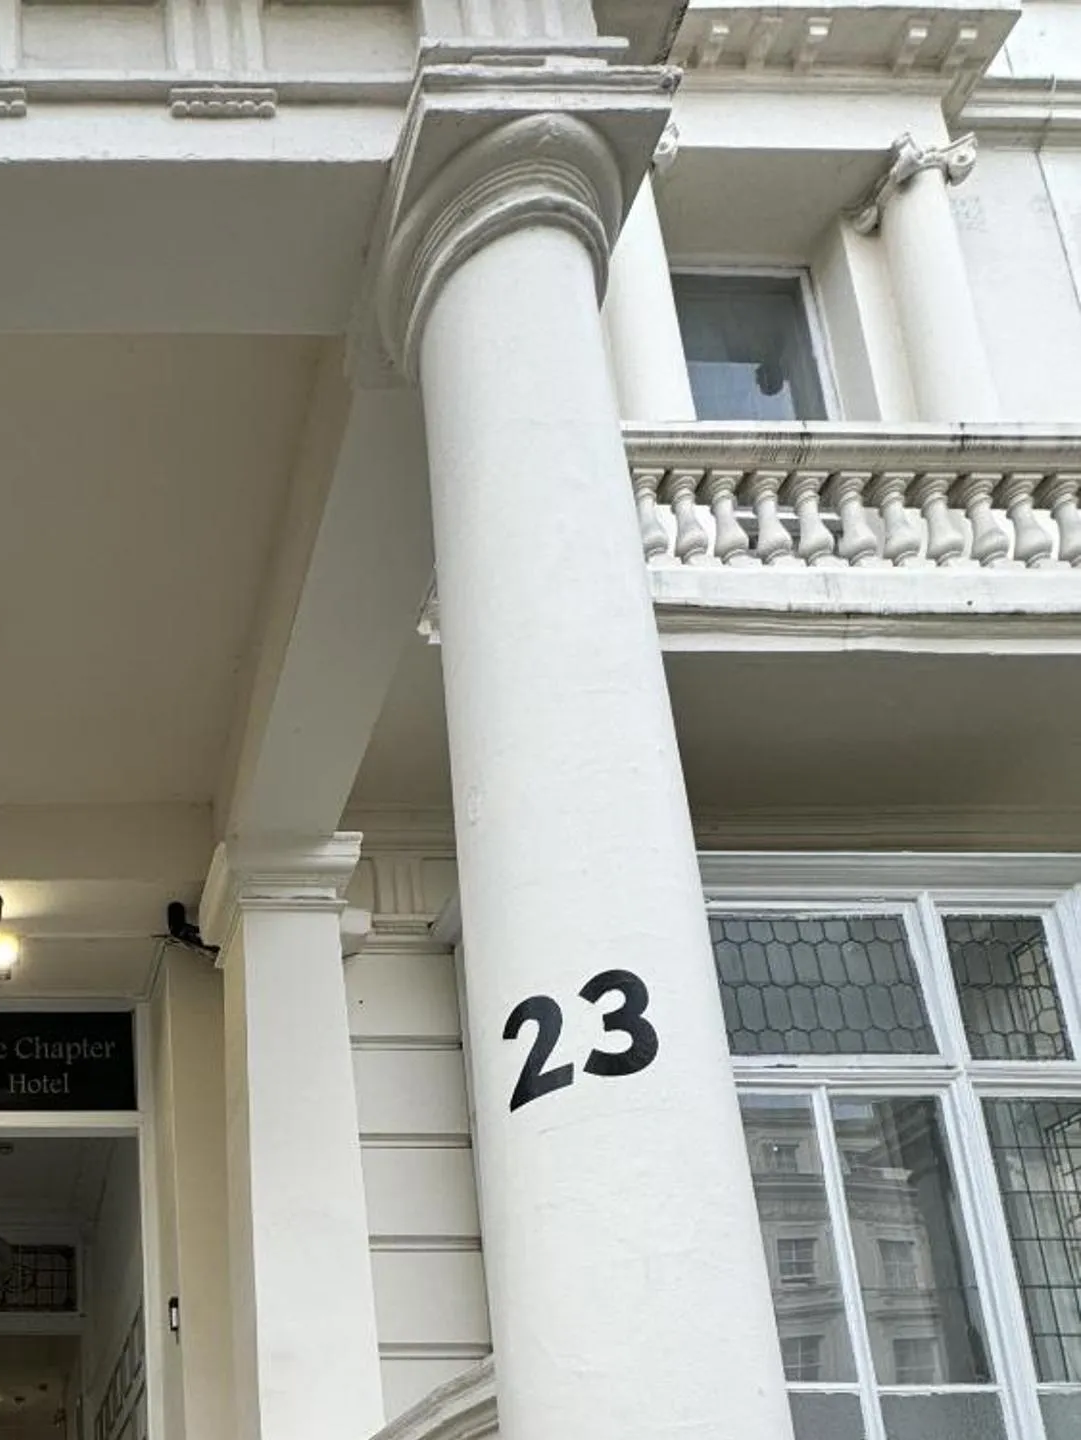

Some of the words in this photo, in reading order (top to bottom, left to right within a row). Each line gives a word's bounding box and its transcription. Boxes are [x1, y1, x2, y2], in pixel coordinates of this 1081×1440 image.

[14, 1036, 117, 1065] Chapter
[502, 969, 659, 1112] 23
[8, 1072, 71, 1095] Hotel
